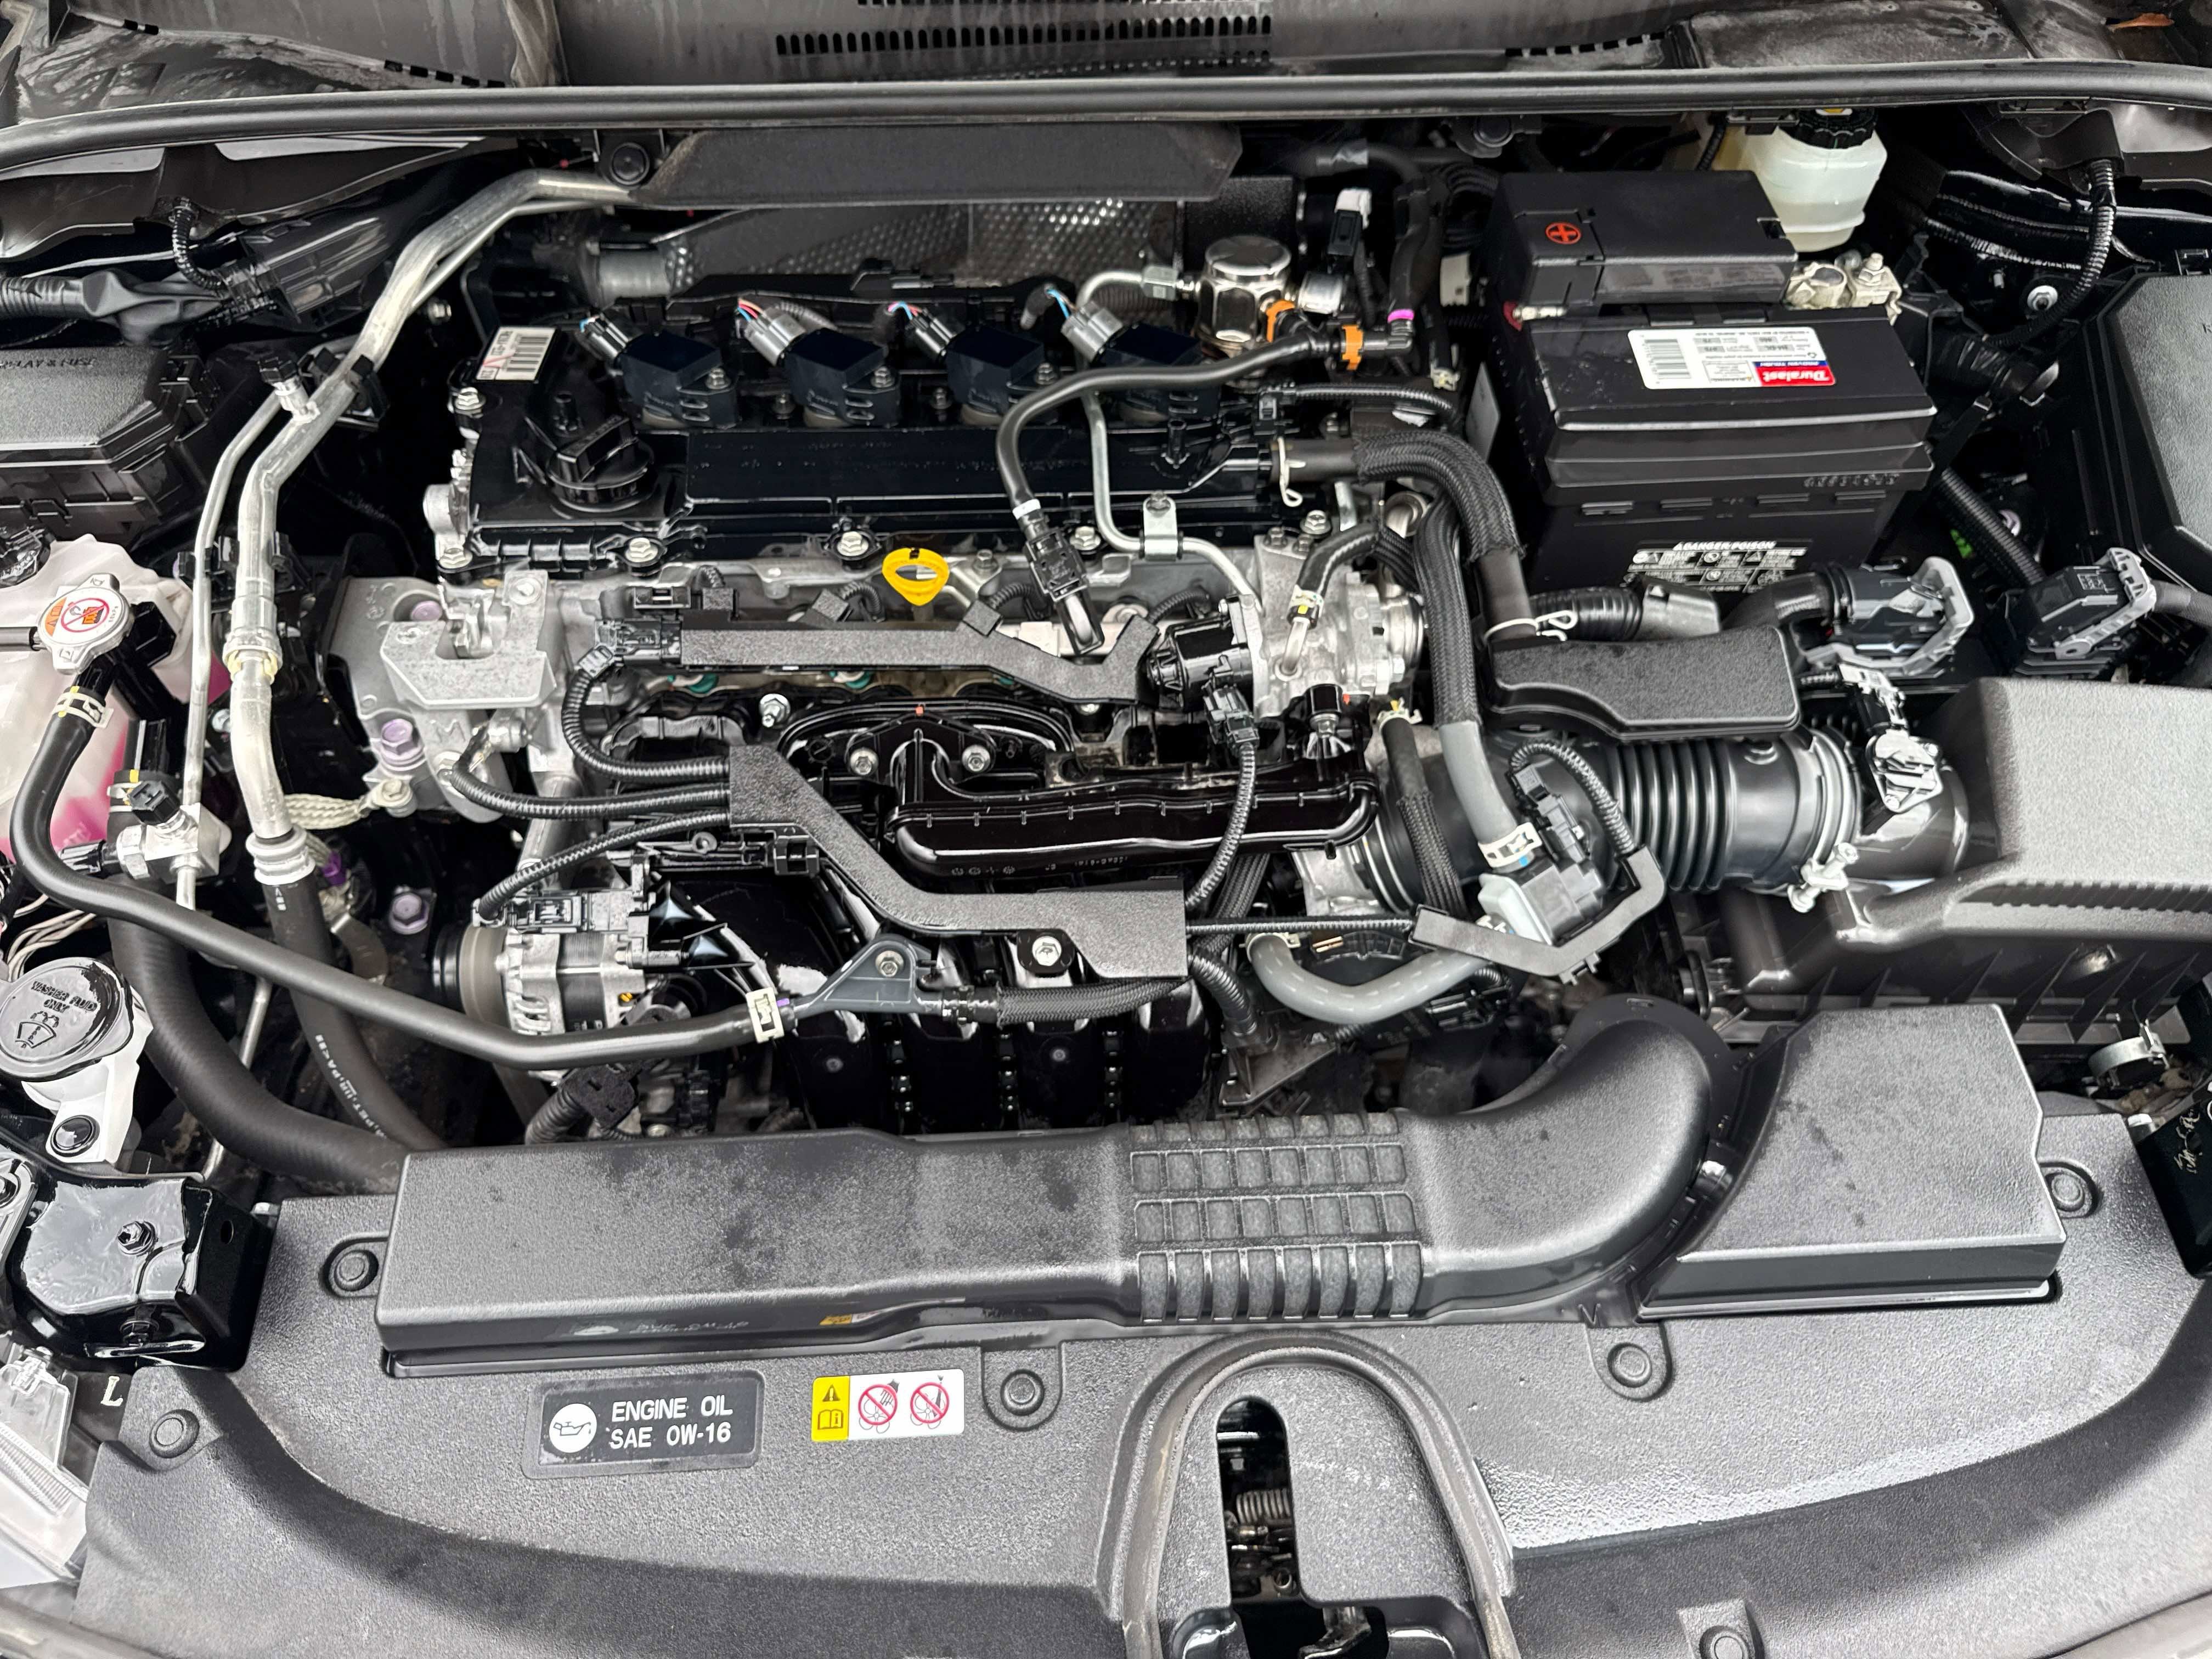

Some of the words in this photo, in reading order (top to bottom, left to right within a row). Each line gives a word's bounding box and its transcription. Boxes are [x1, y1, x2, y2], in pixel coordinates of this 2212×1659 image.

[1762, 370, 1831, 382] Duralast
[30, 981, 70, 1002] WASHER
[69, 996, 98, 1012] FLUID
[43, 998, 70, 1013] ONLY
[100, 1375, 123, 1407] L
[612, 1397, 688, 1422] ENGINE
[700, 1395, 733, 1418] OIL
[610, 1426, 653, 1449] SAE
[666, 1421, 731, 1446] 0W-16
